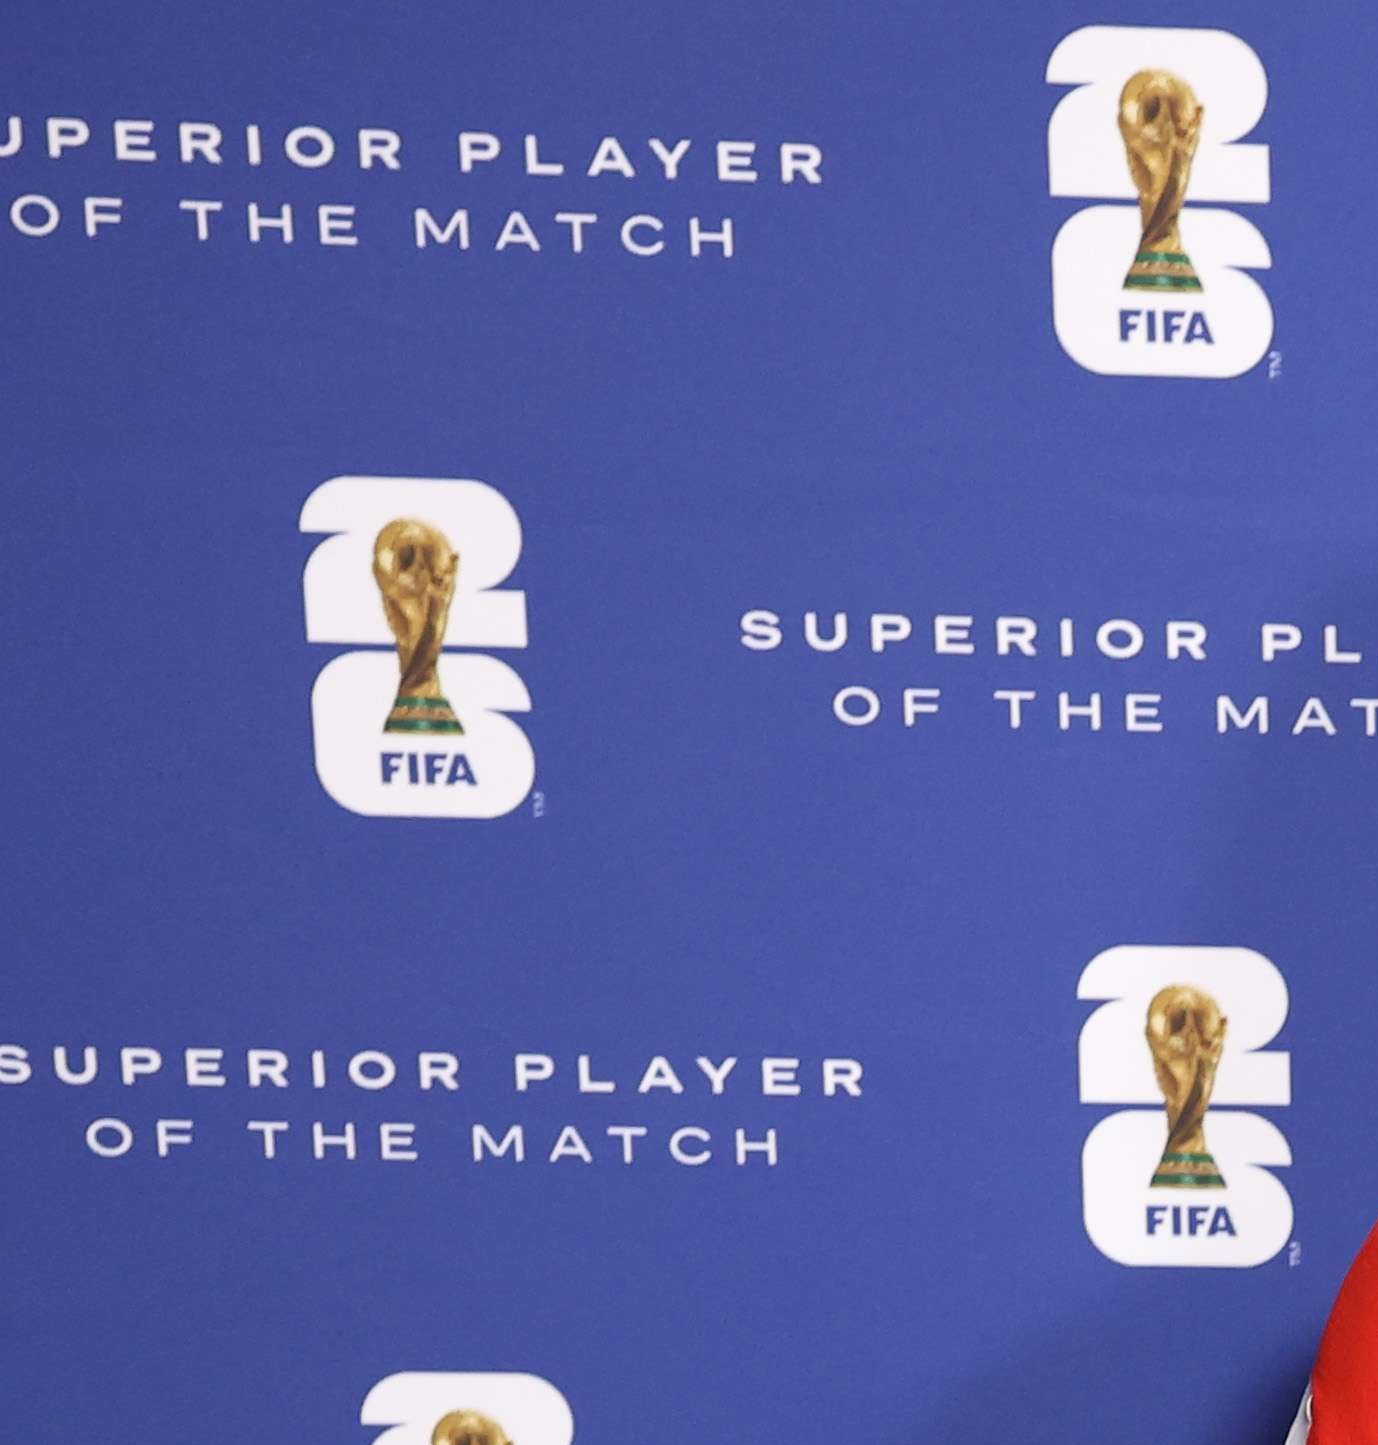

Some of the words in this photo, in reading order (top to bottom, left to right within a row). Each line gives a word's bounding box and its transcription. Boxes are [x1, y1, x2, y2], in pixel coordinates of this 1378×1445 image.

[459, 131, 823, 184] PLAYER
[10, 194, 123, 238] OF
[179, 199, 359, 246] THE
[415, 207, 738, 258] MATCH
[1119, 309, 1214, 345] FIFA
[740, 609, 1207, 661] SUPERIOR
[833, 685, 941, 727] OF
[993, 690, 1164, 733] THE
[380, 751, 478, 786] FIFA
[0, 1044, 459, 1091] SUPERIOR
[514, 1053, 863, 1097] PLAYER
[85, 1117, 194, 1158] OF
[246, 1120, 419, 1161] THE
[472, 1124, 778, 1166] MATCH
[1146, 1205, 1237, 1237] FIFA
